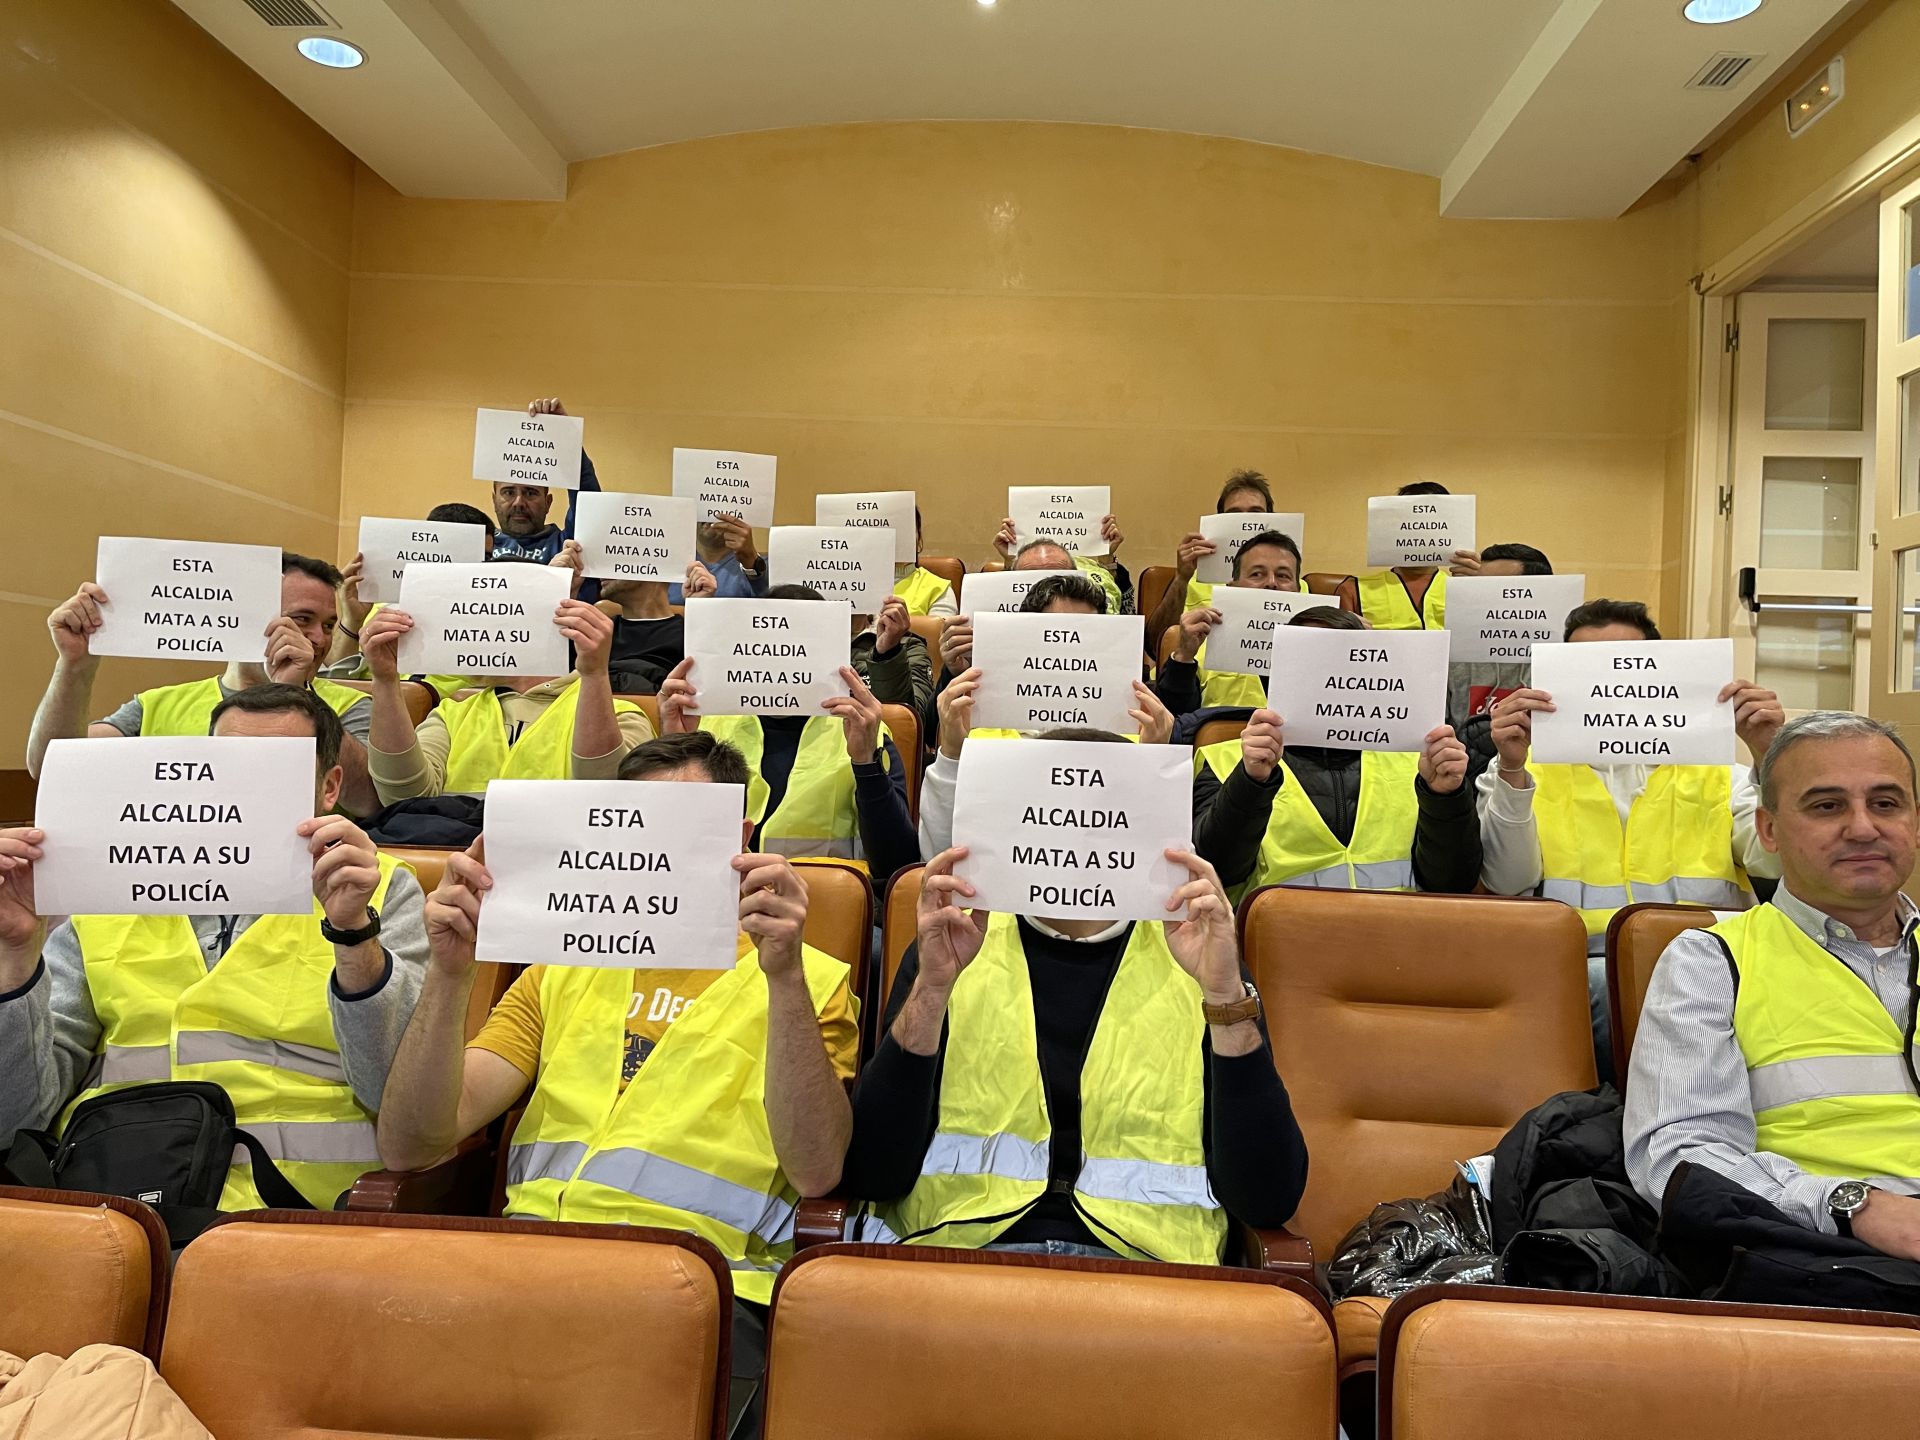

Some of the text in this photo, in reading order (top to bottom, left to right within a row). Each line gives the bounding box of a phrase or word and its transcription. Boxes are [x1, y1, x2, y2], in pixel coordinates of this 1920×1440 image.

[521, 422, 545, 432] ESTA
[507, 437, 555, 450] ALCALDIA
[503, 452, 558, 467] MATA A SU
[716, 460, 740, 471] ESTA
[510, 469, 548, 481] POLICÍA
[703, 476, 750, 489] ALCALDIA
[699, 493, 752, 506] MATA A SU
[1051, 495, 1074, 503] ESTA
[624, 506, 652, 518] ESTA
[856, 502, 879, 511] ESTA
[1412, 505, 1437, 514] ESTA
[1039, 511, 1084, 520] ALCALDIA
[844, 518, 890, 528] ALCALDIA
[1242, 522, 1265, 531] ESTA
[1400, 521, 1448, 531] ALCALDIA
[411, 531, 439, 543] ESTA
[609, 525, 665, 538] ALCALDIA
[1035, 527, 1087, 536] MATA A SU
[821, 539, 849, 550] ESTA
[1396, 538, 1450, 547] MATA A SU
[396, 550, 453, 564] ALCALDIA
[605, 544, 669, 558] MATA A SU
[1404, 551, 1443, 562] POLICÍA
[173, 558, 214, 573] ESTA
[614, 562, 658, 576] POLICÍA
[806, 560, 862, 571] ALCALDIA
[471, 577, 508, 589] ESTA
[802, 580, 866, 592] MATA A SU
[1012, 583, 1032, 593] EST
[151, 585, 233, 602] ALCALDIA
[1502, 588, 1533, 599] ESTA
[450, 602, 525, 616] ALCALDIA
[1264, 601, 1291, 613] ESTA
[144, 612, 239, 629] MATA A SU
[1485, 609, 1547, 620] ALCALDIA
[752, 616, 790, 630] ESTA
[443, 629, 530, 643] MATA A SU
[1043, 630, 1081, 644] ESTA
[1480, 629, 1551, 640] MATA A SU
[157, 636, 224, 653] POLICÍA
[732, 643, 807, 657] ALCALDIA
[1349, 648, 1389, 663] ESTA
[1489, 646, 1532, 658] POLICÍ
[457, 651, 518, 668] POLICÍA
[1023, 657, 1098, 672] ALCALDIA
[1613, 657, 1657, 670] ESTA
[727, 670, 812, 685] MATA A SU
[1324, 676, 1405, 692] ALCALDIA
[1016, 683, 1102, 700] MATA A SU
[1590, 684, 1679, 699] ALCALDIA
[740, 692, 800, 708] POLICÍA
[1028, 707, 1088, 724] POLICÍA
[1315, 703, 1409, 720] MATA A SU
[1583, 713, 1686, 728] MATA A SU
[1326, 728, 1390, 744] POLICÍA
[1599, 737, 1671, 755] POLICÍA
[155, 762, 215, 781] ESTA
[1051, 767, 1105, 788] ESTA
[119, 803, 242, 823] ALCALDIA
[588, 808, 645, 828] ESTA
[1021, 806, 1129, 829] ALCALDIA
[109, 845, 250, 865] MATA A SU
[558, 850, 671, 872] ALCALDIA
[1012, 845, 1135, 870] MATA A SU
[132, 878, 230, 902] POLICÍA
[1029, 883, 1116, 907] POLICÍA
[547, 892, 678, 915] MATA A SU
[563, 929, 656, 955] POLICÍA
